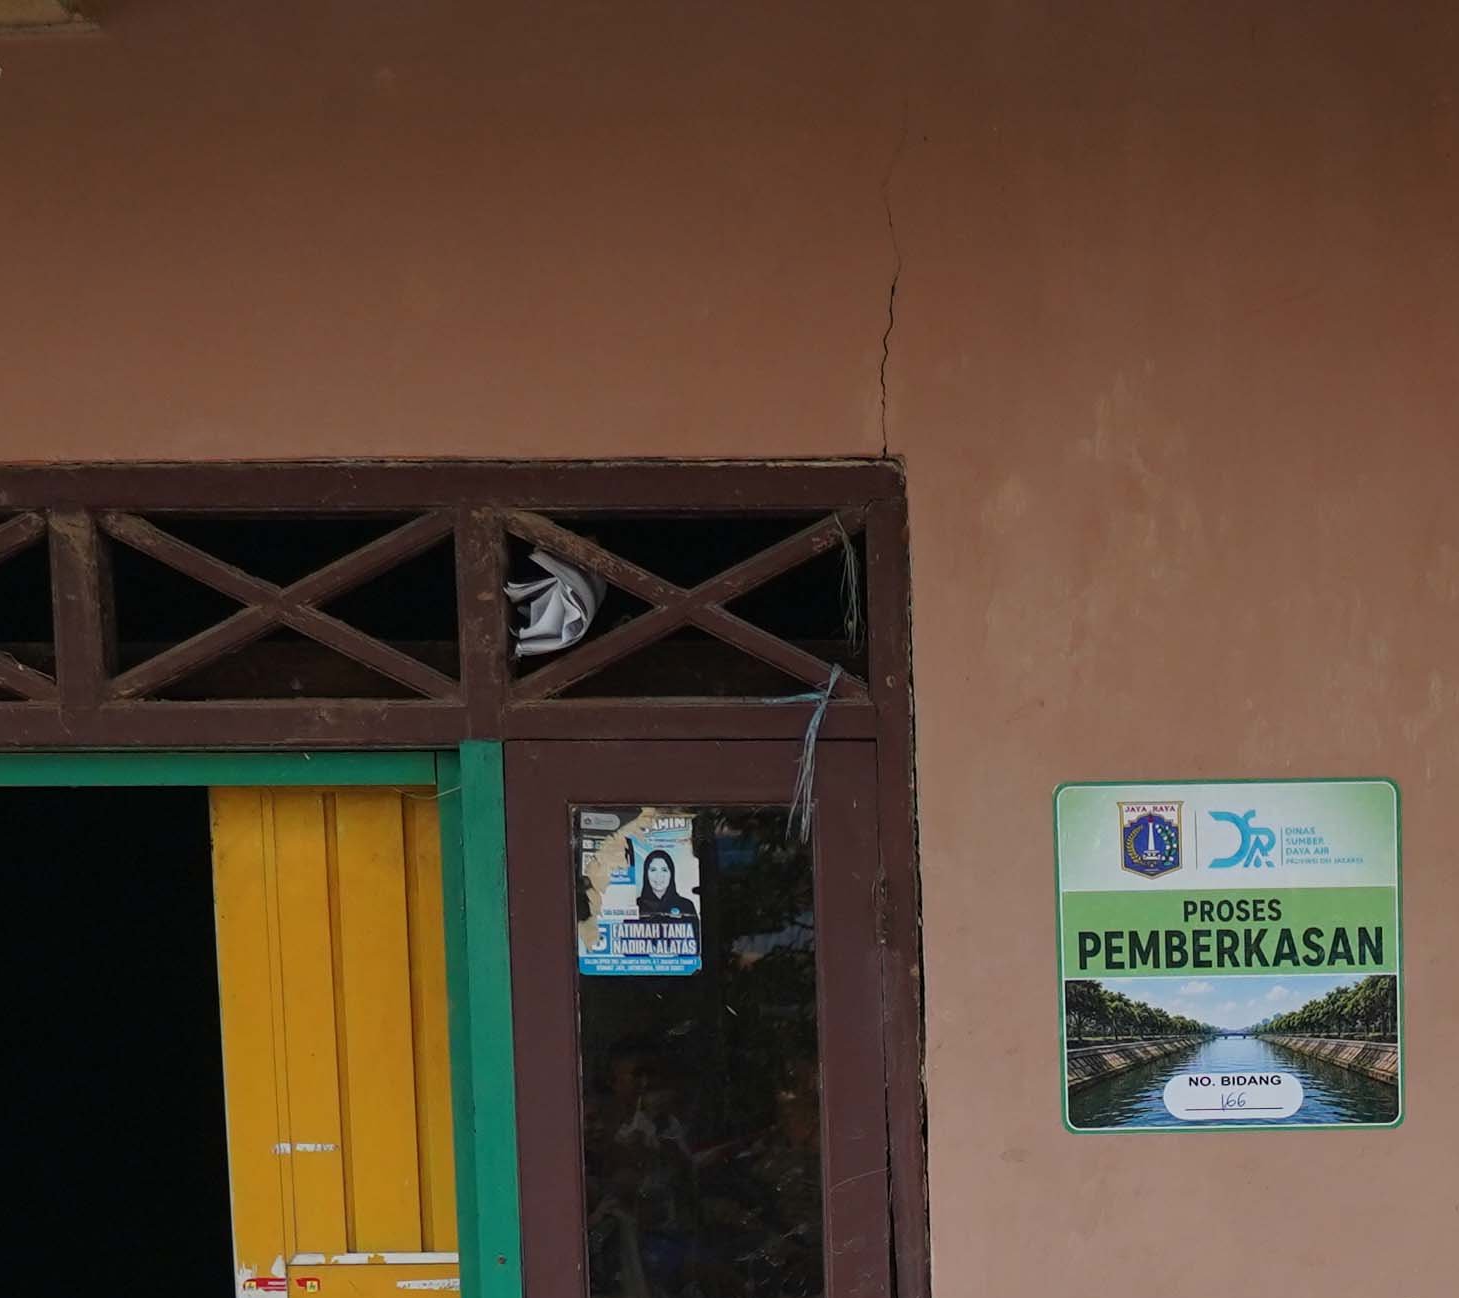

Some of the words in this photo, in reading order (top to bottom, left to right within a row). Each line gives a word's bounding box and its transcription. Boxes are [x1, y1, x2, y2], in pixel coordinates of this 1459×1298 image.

[1285, 827, 1316, 835] DINAS
[1285, 837, 1325, 846] SUMBER
[1285, 847, 1311, 856] DAYA
[1313, 847, 1330, 855] AIR
[1183, 899, 1282, 922] PROSES
[612, 923, 660, 938] FATIMAH
[661, 923, 694, 938] TANIA
[613, 939, 654, 954] NADIRA
[656, 939, 697, 954] ALATAS
[1078, 927, 1384, 971] PEMBERKASAN
[1188, 1076, 1216, 1087] NO.
[1221, 1075, 1282, 1086] BIDANG
[1221, 1092, 1246, 1112] 166
